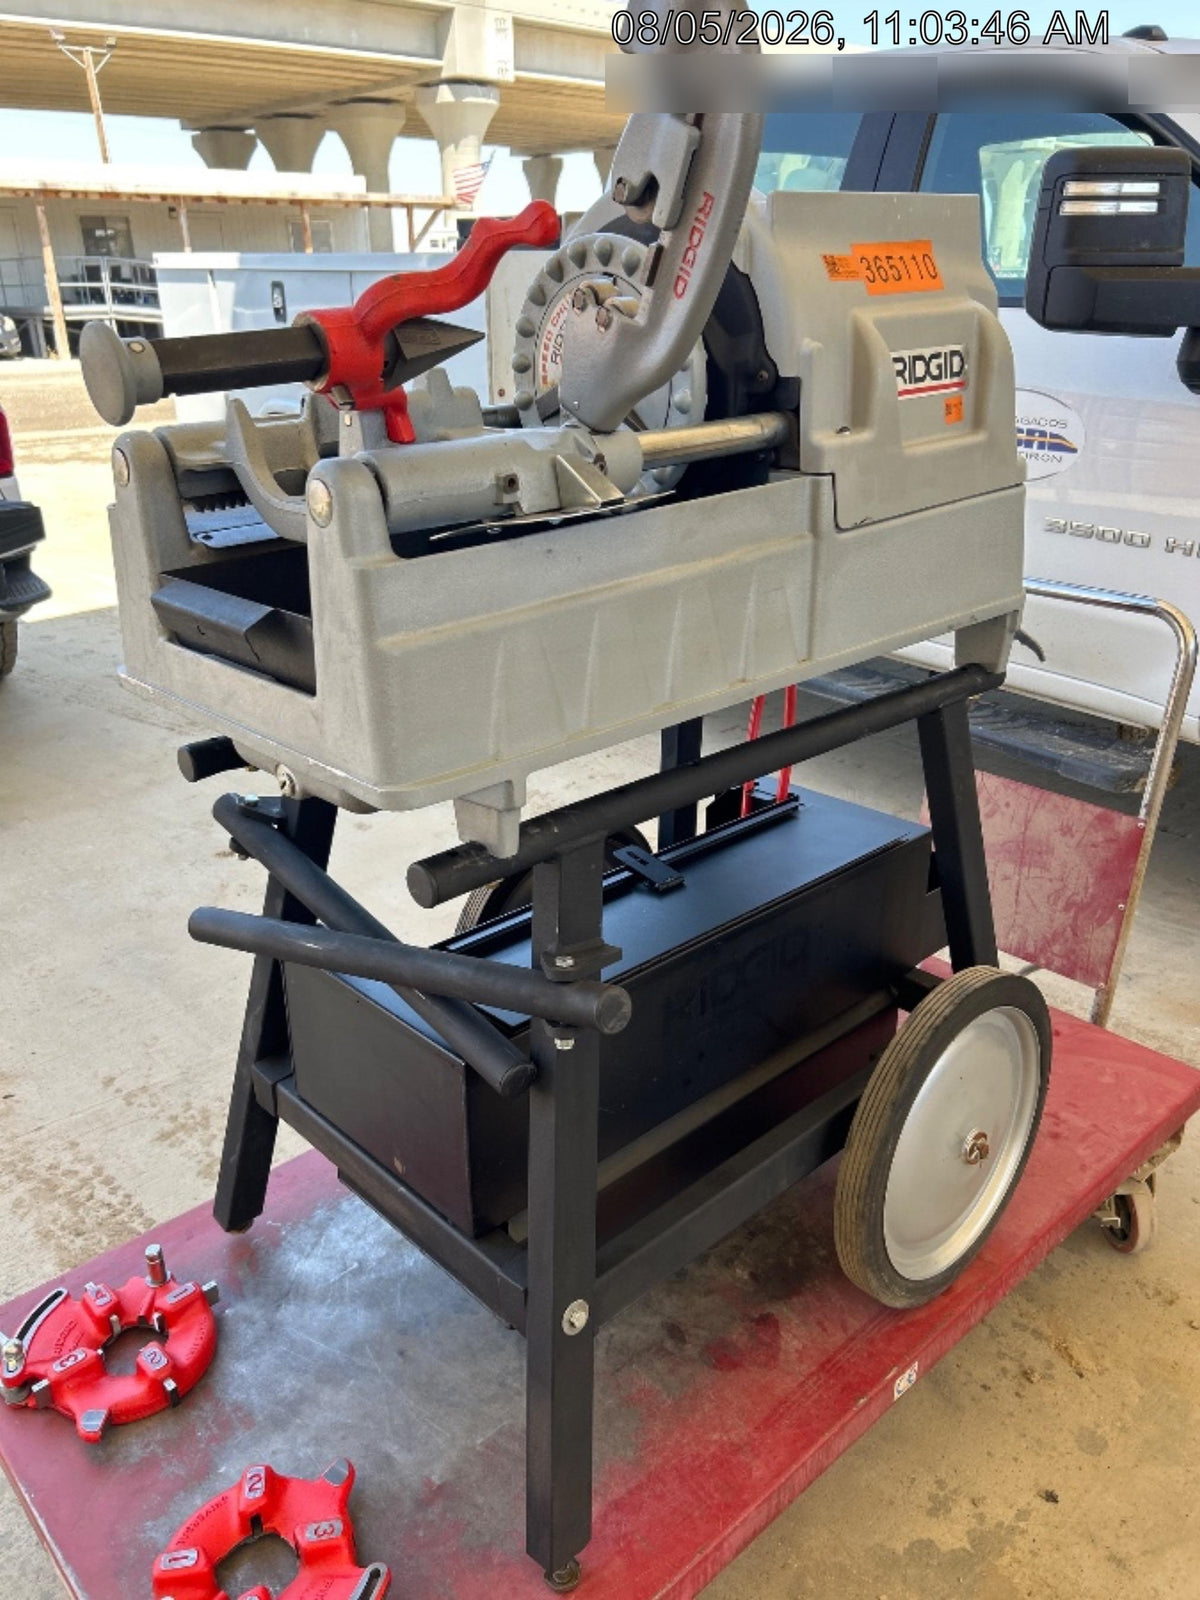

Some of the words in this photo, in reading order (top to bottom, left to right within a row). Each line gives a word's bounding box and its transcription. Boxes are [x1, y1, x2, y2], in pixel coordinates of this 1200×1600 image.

[674, 191, 715, 299] RIDGID
[860, 254, 938, 283] 365110
[892, 350, 964, 385] RIDGID
[1044, 516, 1151, 549] 3500
[1164, 536, 1200, 559] H
[60, 1354, 79, 1368] 3
[147, 1350, 162, 1366] 2
[248, 1473, 263, 1494] 2
[314, 1523, 335, 1538] 3
